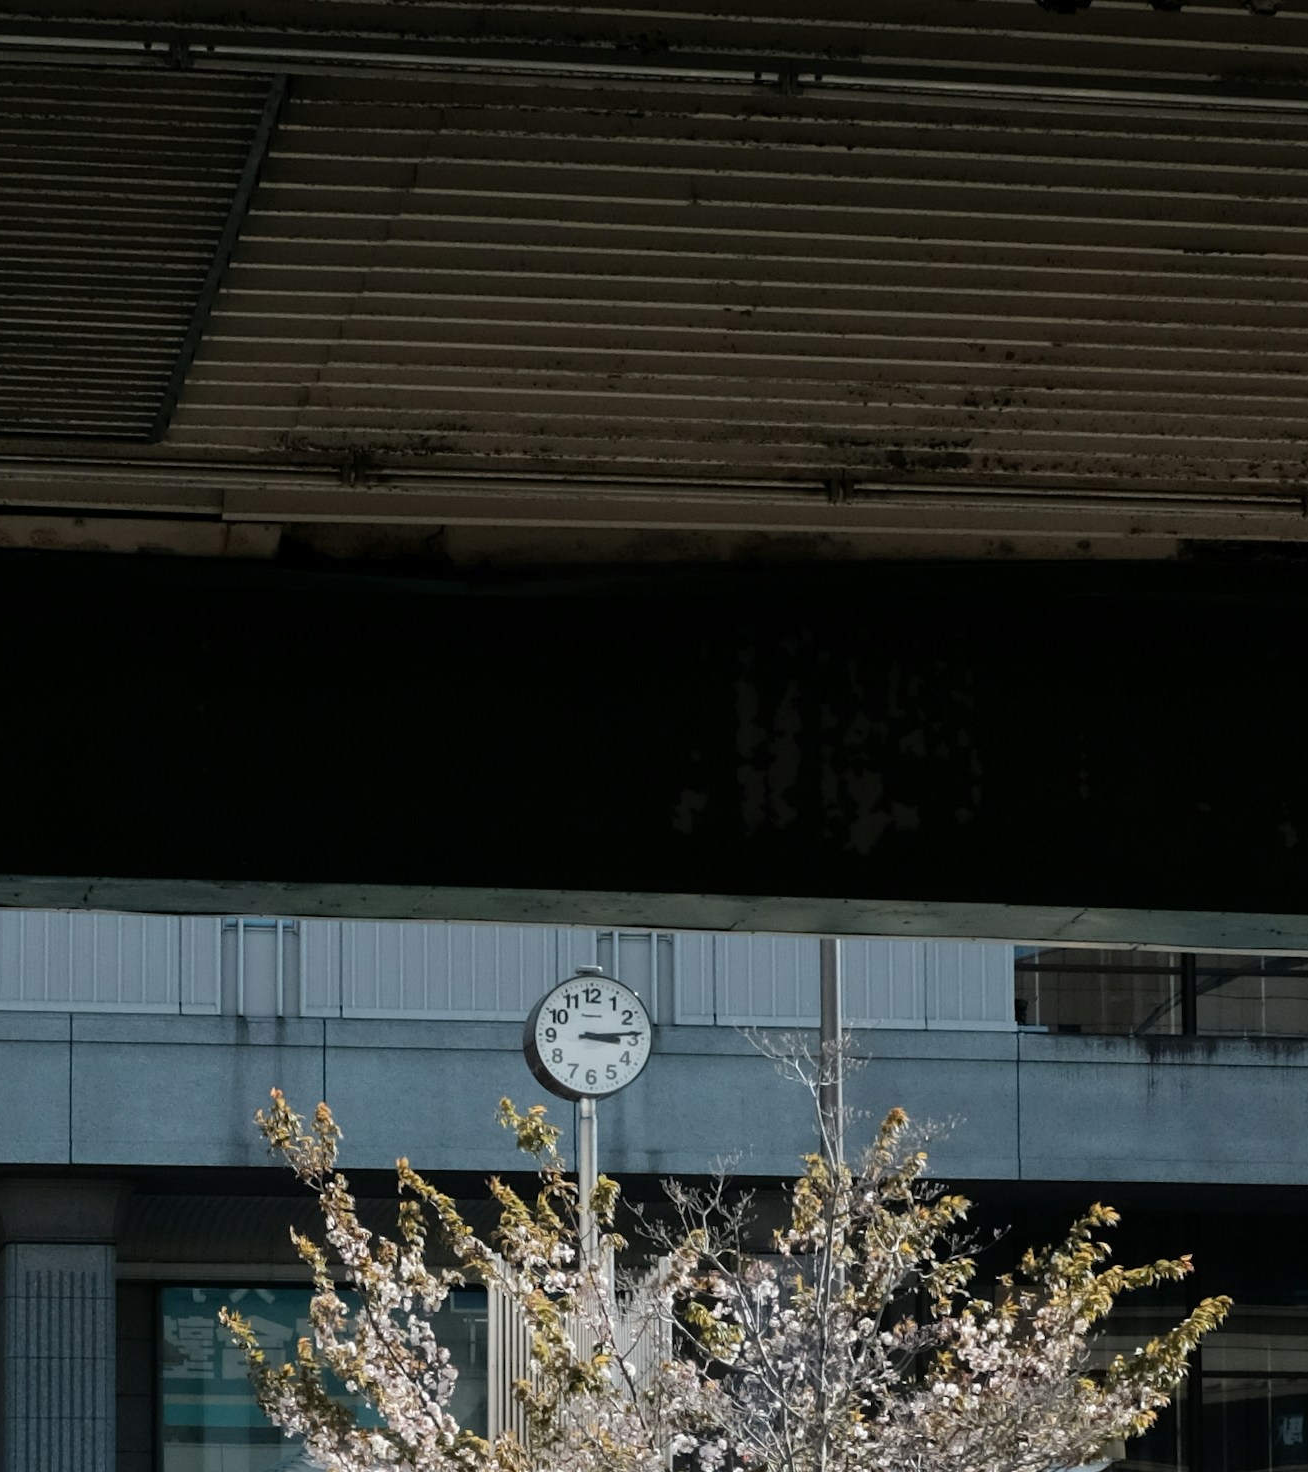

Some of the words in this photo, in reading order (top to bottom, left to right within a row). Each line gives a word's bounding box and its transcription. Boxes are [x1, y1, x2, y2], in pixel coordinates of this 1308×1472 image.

[564, 994, 579, 1009] 11
[583, 989, 601, 1003] 12
[609, 997, 617, 1011] 1
[550, 1010, 568, 1024] 10
[622, 1011, 633, 1025] 2
[545, 1028, 556, 1043] 9
[627, 1031, 639, 1046] 3
[552, 1048, 563, 1063] 8
[620, 1051, 631, 1066] 4
[568, 1064, 579, 1079] 7
[586, 1070, 597, 1084] 6
[606, 1065, 617, 1080] 5
